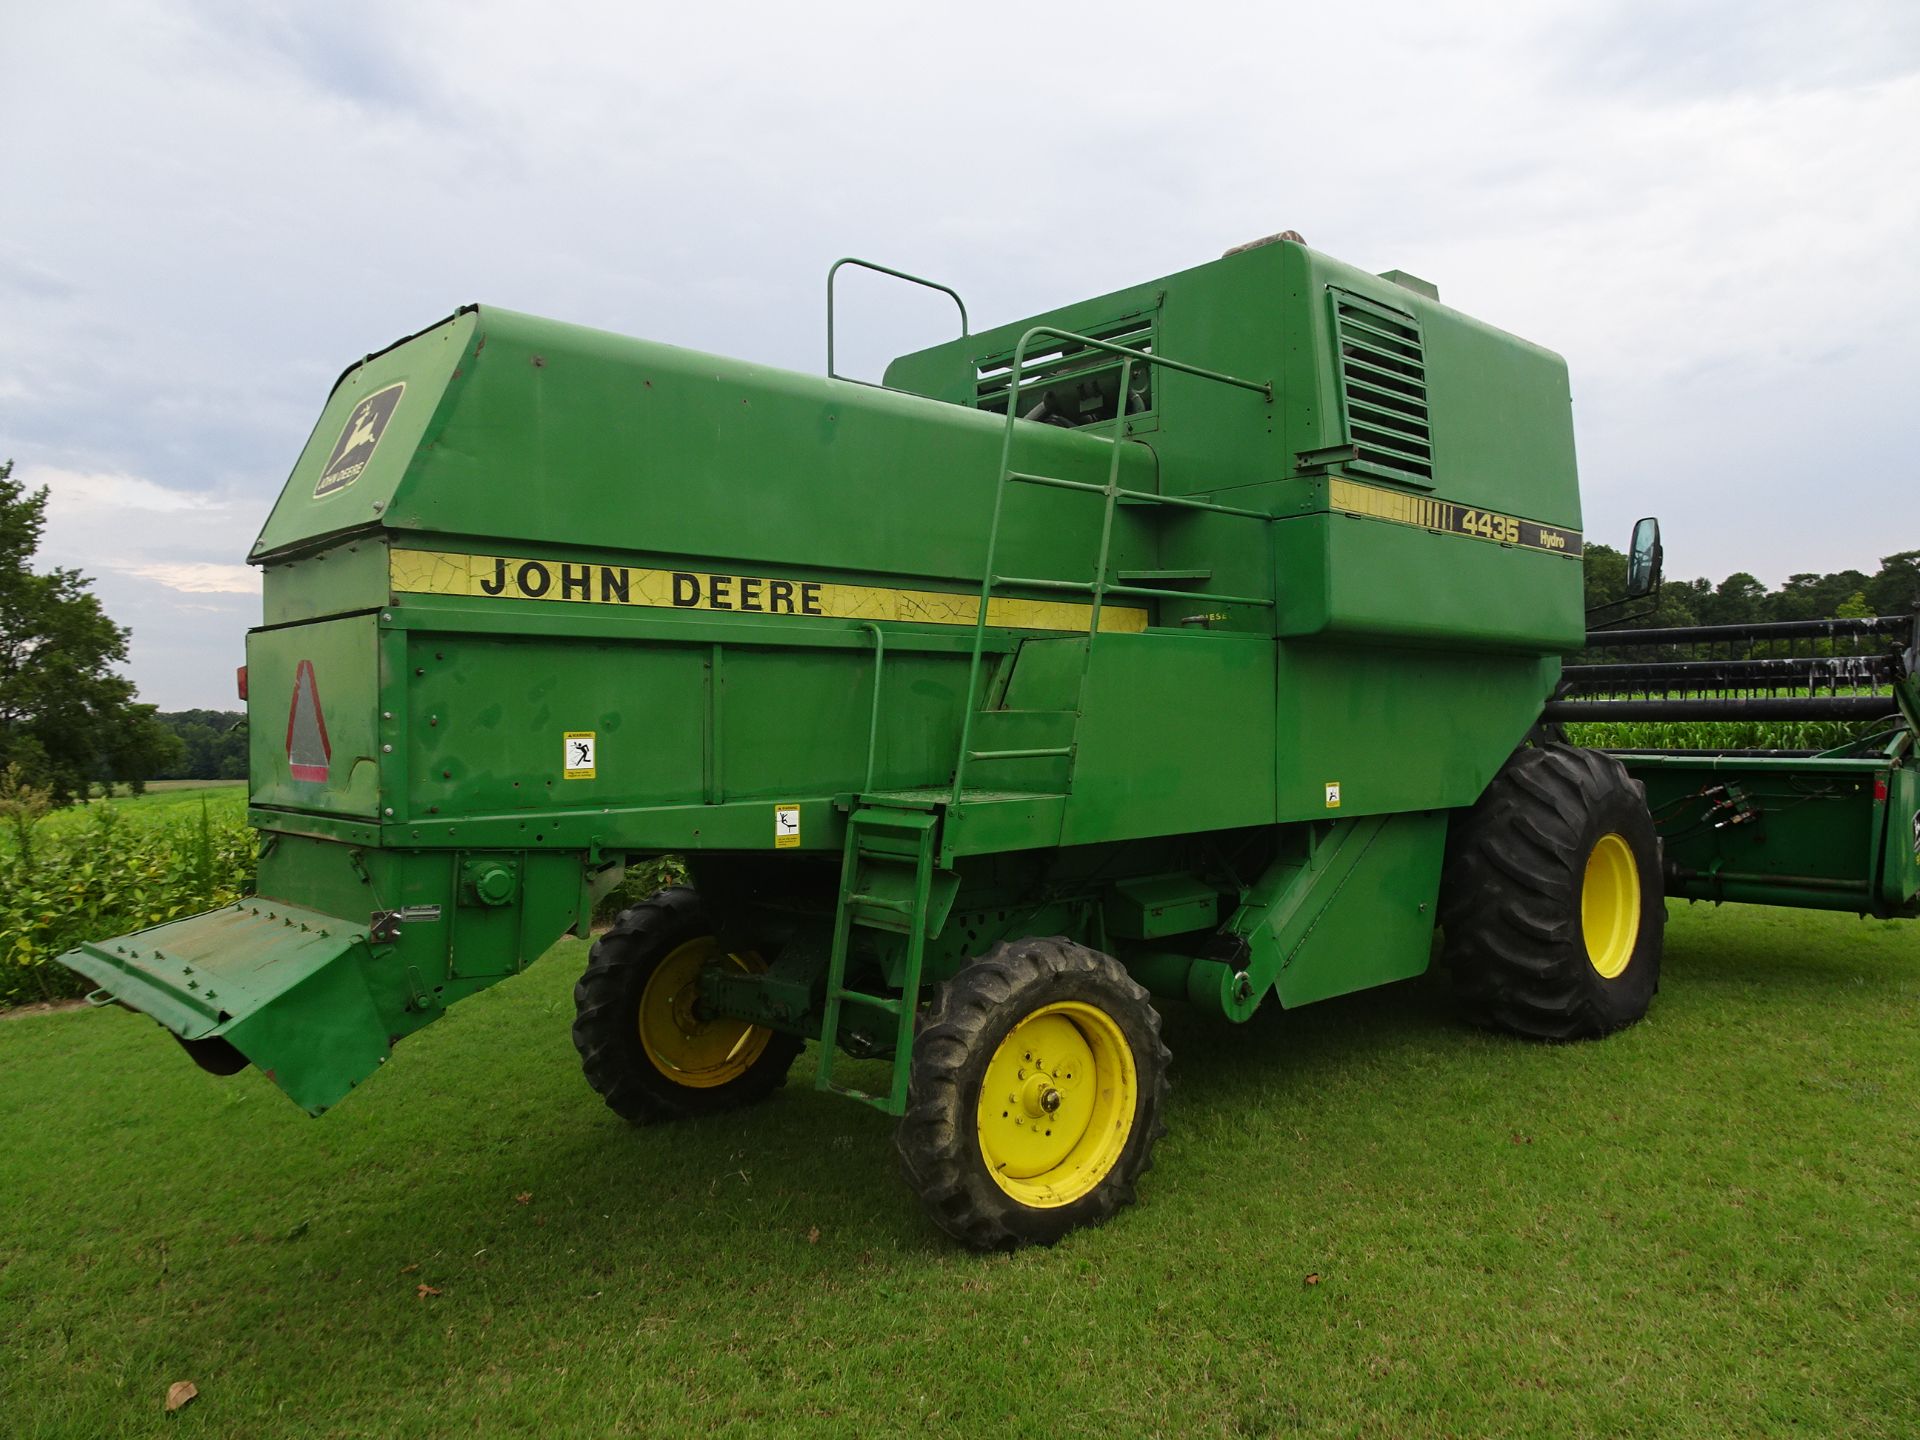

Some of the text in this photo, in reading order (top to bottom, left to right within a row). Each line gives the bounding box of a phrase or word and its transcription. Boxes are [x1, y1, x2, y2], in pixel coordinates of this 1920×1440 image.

[1462, 510, 1519, 543] 4435
[1540, 529, 1565, 549] Hydro
[480, 558, 822, 615] JOHN DEERE
